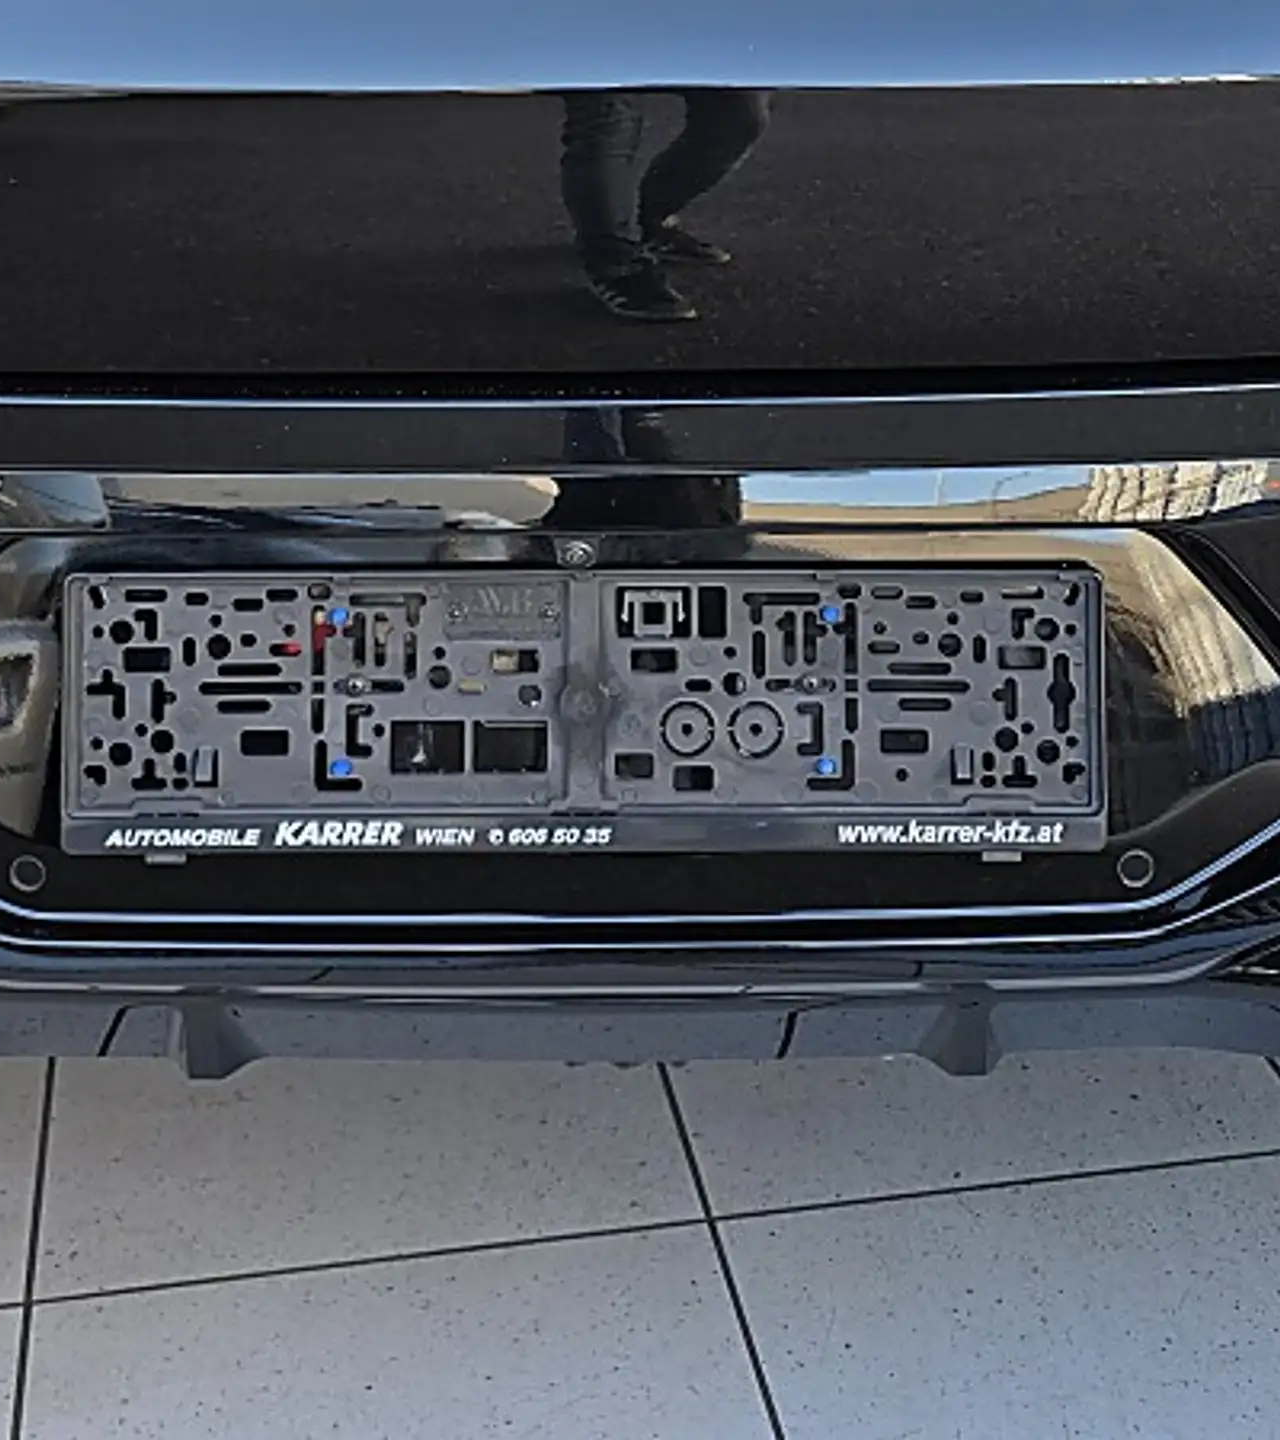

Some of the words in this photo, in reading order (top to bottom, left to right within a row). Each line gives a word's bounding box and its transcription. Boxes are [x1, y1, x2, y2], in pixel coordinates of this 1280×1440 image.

[104, 827, 261, 848] AUTOMOBILE
[274, 820, 404, 848] KARRER
[415, 827, 476, 847] WIEN
[582, 826, 613, 845] 35
[837, 819, 1065, 844] www.karrer-kfz.at
